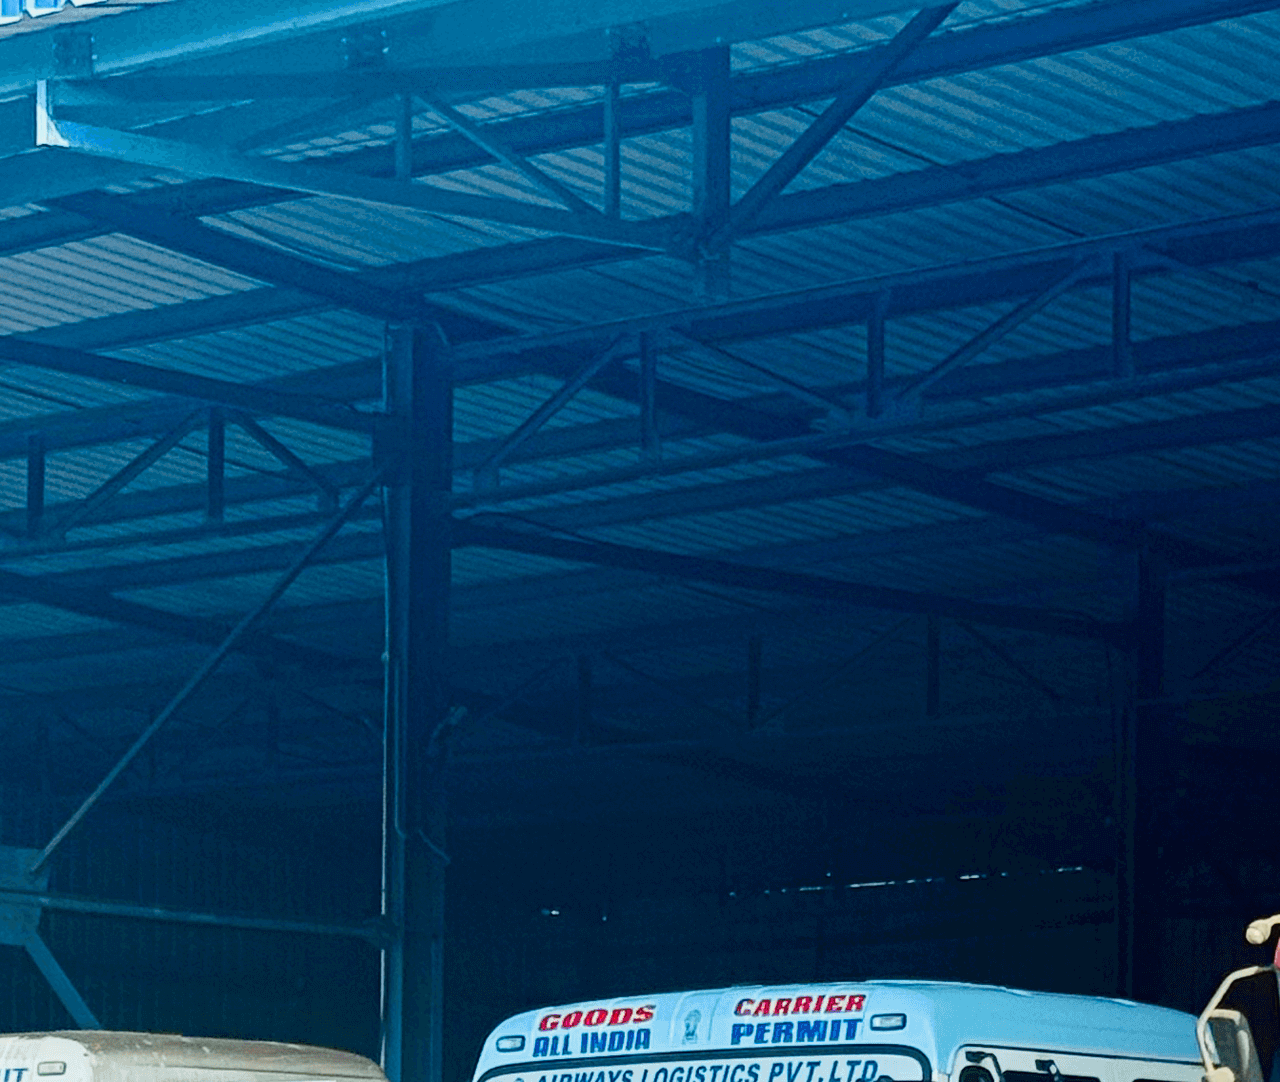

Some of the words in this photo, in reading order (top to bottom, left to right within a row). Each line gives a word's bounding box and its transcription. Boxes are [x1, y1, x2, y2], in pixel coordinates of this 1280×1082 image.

[539, 1004, 655, 1031] GOODS
[735, 994, 866, 1017] CARRIER
[533, 1036, 570, 1057] ALL
[581, 1028, 651, 1052] INDIA
[731, 1018, 862, 1046] PERMIT
